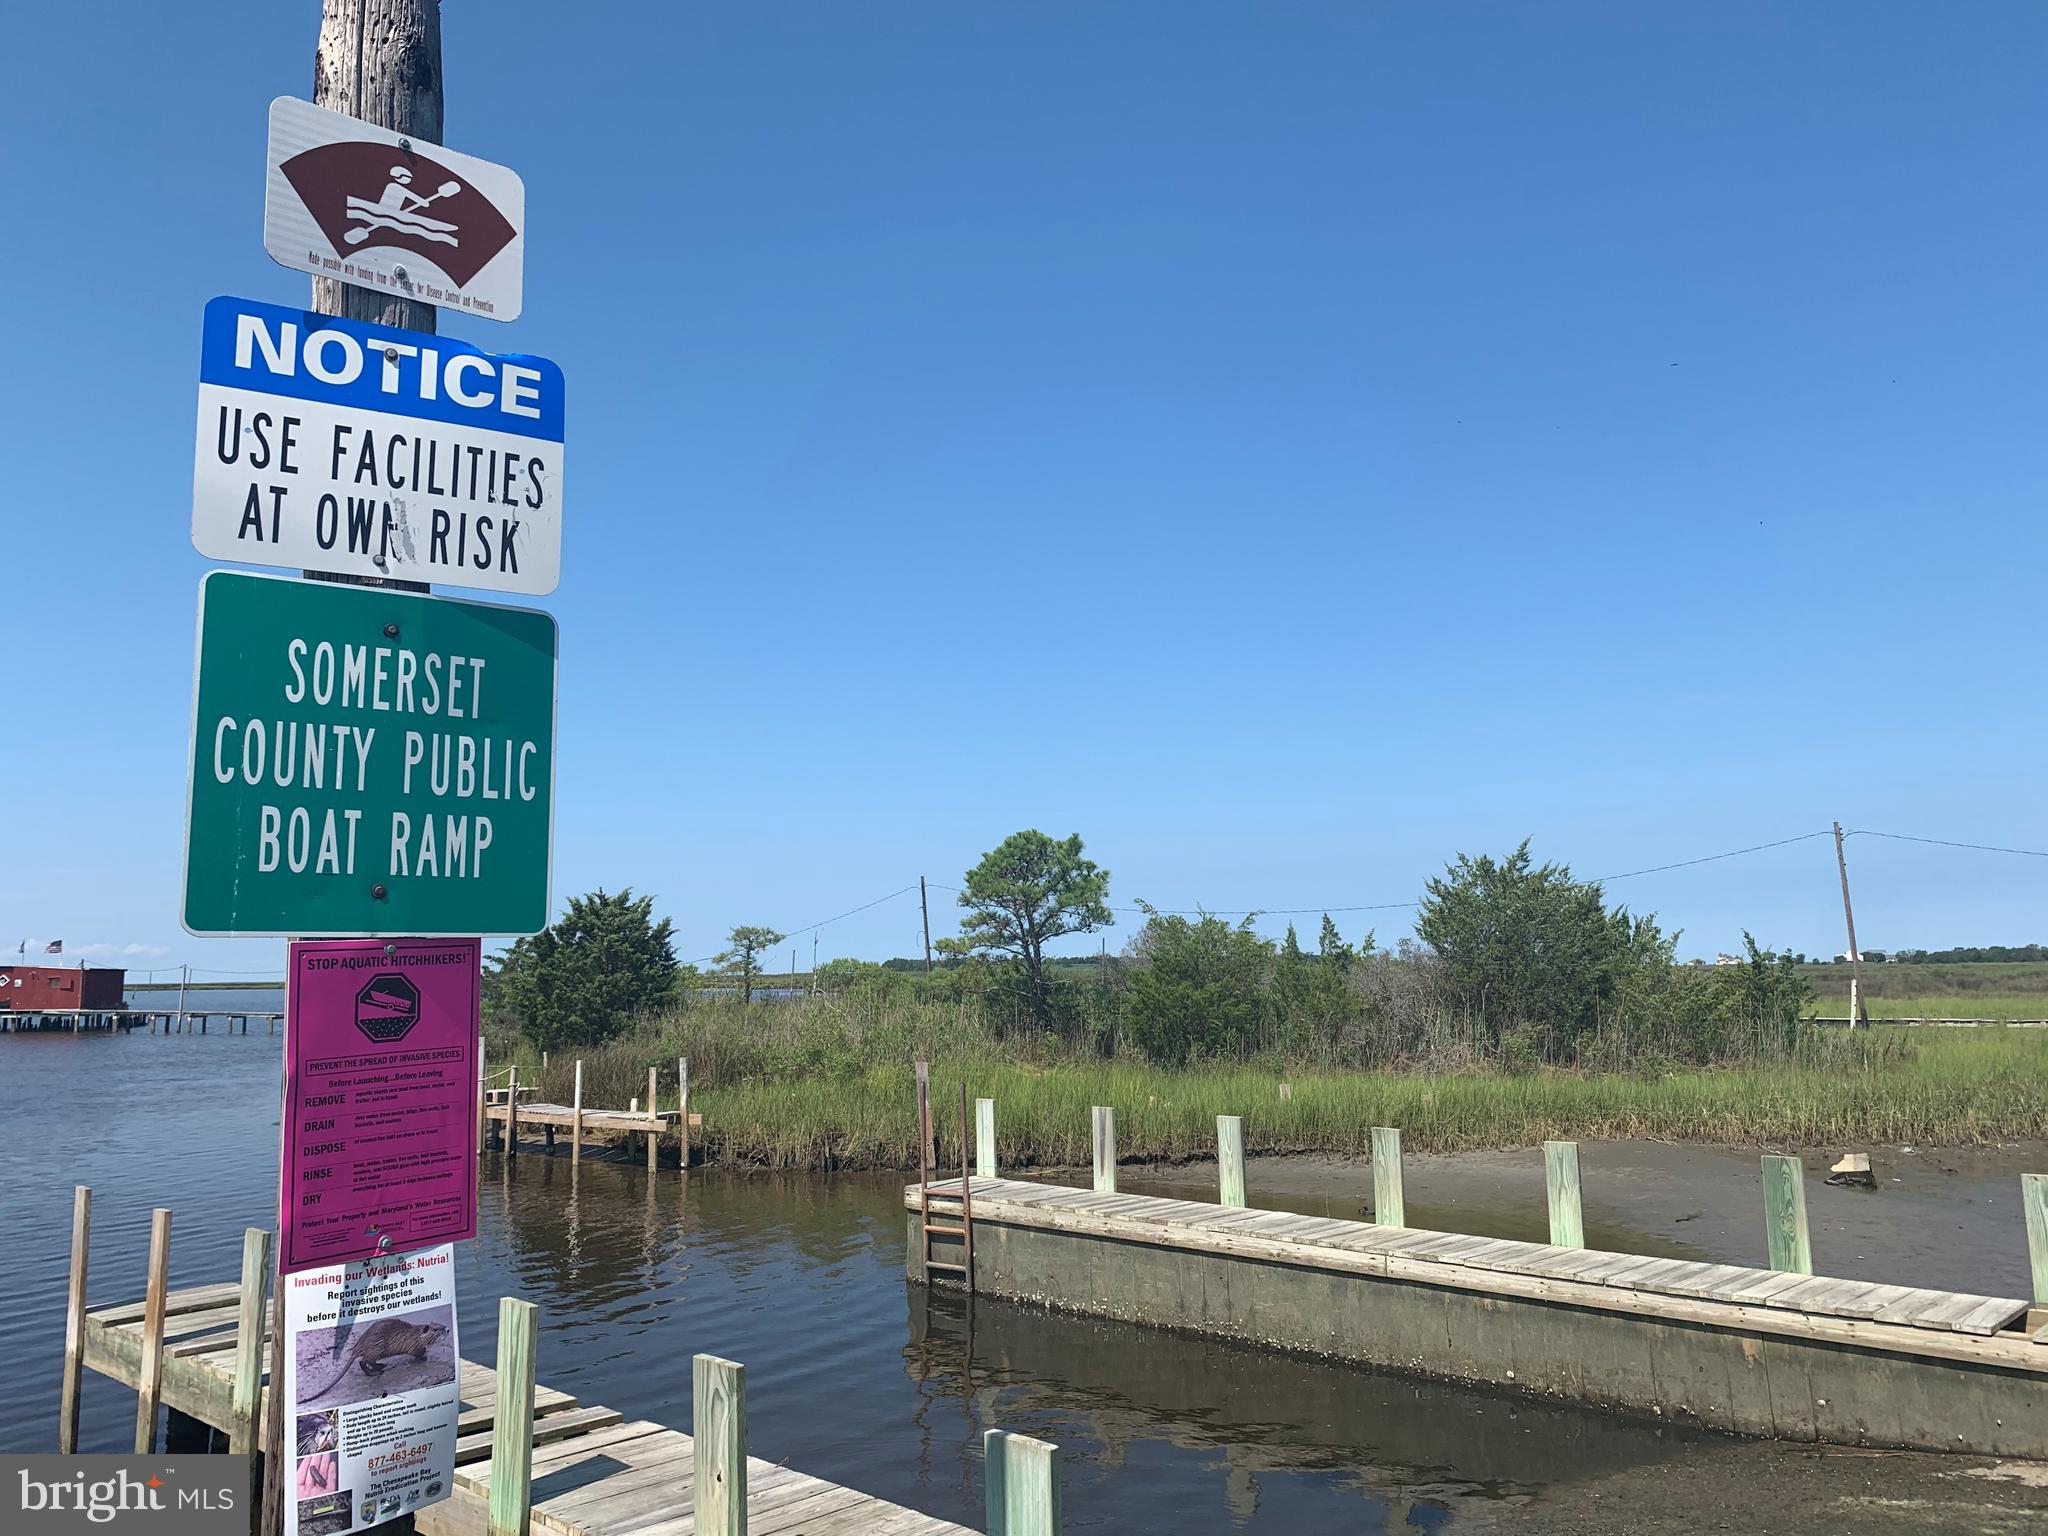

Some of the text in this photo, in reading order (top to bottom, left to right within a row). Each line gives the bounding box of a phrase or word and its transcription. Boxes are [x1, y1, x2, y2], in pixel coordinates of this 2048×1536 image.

[309, 251, 319, 265] Made
[323, 257, 341, 271] possible
[345, 262, 354, 275] with
[358, 265, 373, 284] funding
[377, 270, 386, 284] from
[427, 284, 442, 300] Disease
[445, 290, 460, 304] Control
[473, 297, 494, 313] Prevention
[235, 314, 541, 419] NOTICE
[218, 406, 545, 510] USE FACILITIES
[238, 483, 520, 574] AT OWN RISK
[286, 638, 486, 719] SOMERSET
[214, 716, 537, 801] COUNTY PUBLIC
[258, 805, 492, 878] BOAT RAMP
[308, 953, 466, 970] STOP AQUATIC HITCHHIKERS!
[310, 1050, 460, 1072] PREVENT THE SPREAD OF INVASIVE SPECIES
[305, 1095, 346, 1108] REMOVE
[304, 1120, 335, 1132] DRAIN
[304, 1142, 346, 1156] DISPOSE
[303, 1168, 333, 1181] RINSE
[303, 1194, 322, 1206] DRY
[302, 1219, 324, 1229] Protect
[326, 1216, 339, 1225] Your
[341, 1212, 366, 1222] Property
[381, 1203, 413, 1215] Maryland's
[415, 1200, 431, 1209] Water
[433, 1196, 461, 1205] Resources
[295, 1253, 449, 1287] Invading our Wetlands: Nutria!
[328, 1277, 424, 1300] Report sightings of this
[342, 1289, 412, 1307] invasive species
[307, 1291, 442, 1322] before it destroys our wetlands!
[368, 1442, 432, 1468] 877-463-6497
[394, 1441, 406, 1450] Call
[379, 1465, 398, 1474] report
[399, 1457, 426, 1468] sightings
[365, 1471, 440, 1499] Nutria Eradication Project
[383, 1472, 418, 1486] Chesapeake
